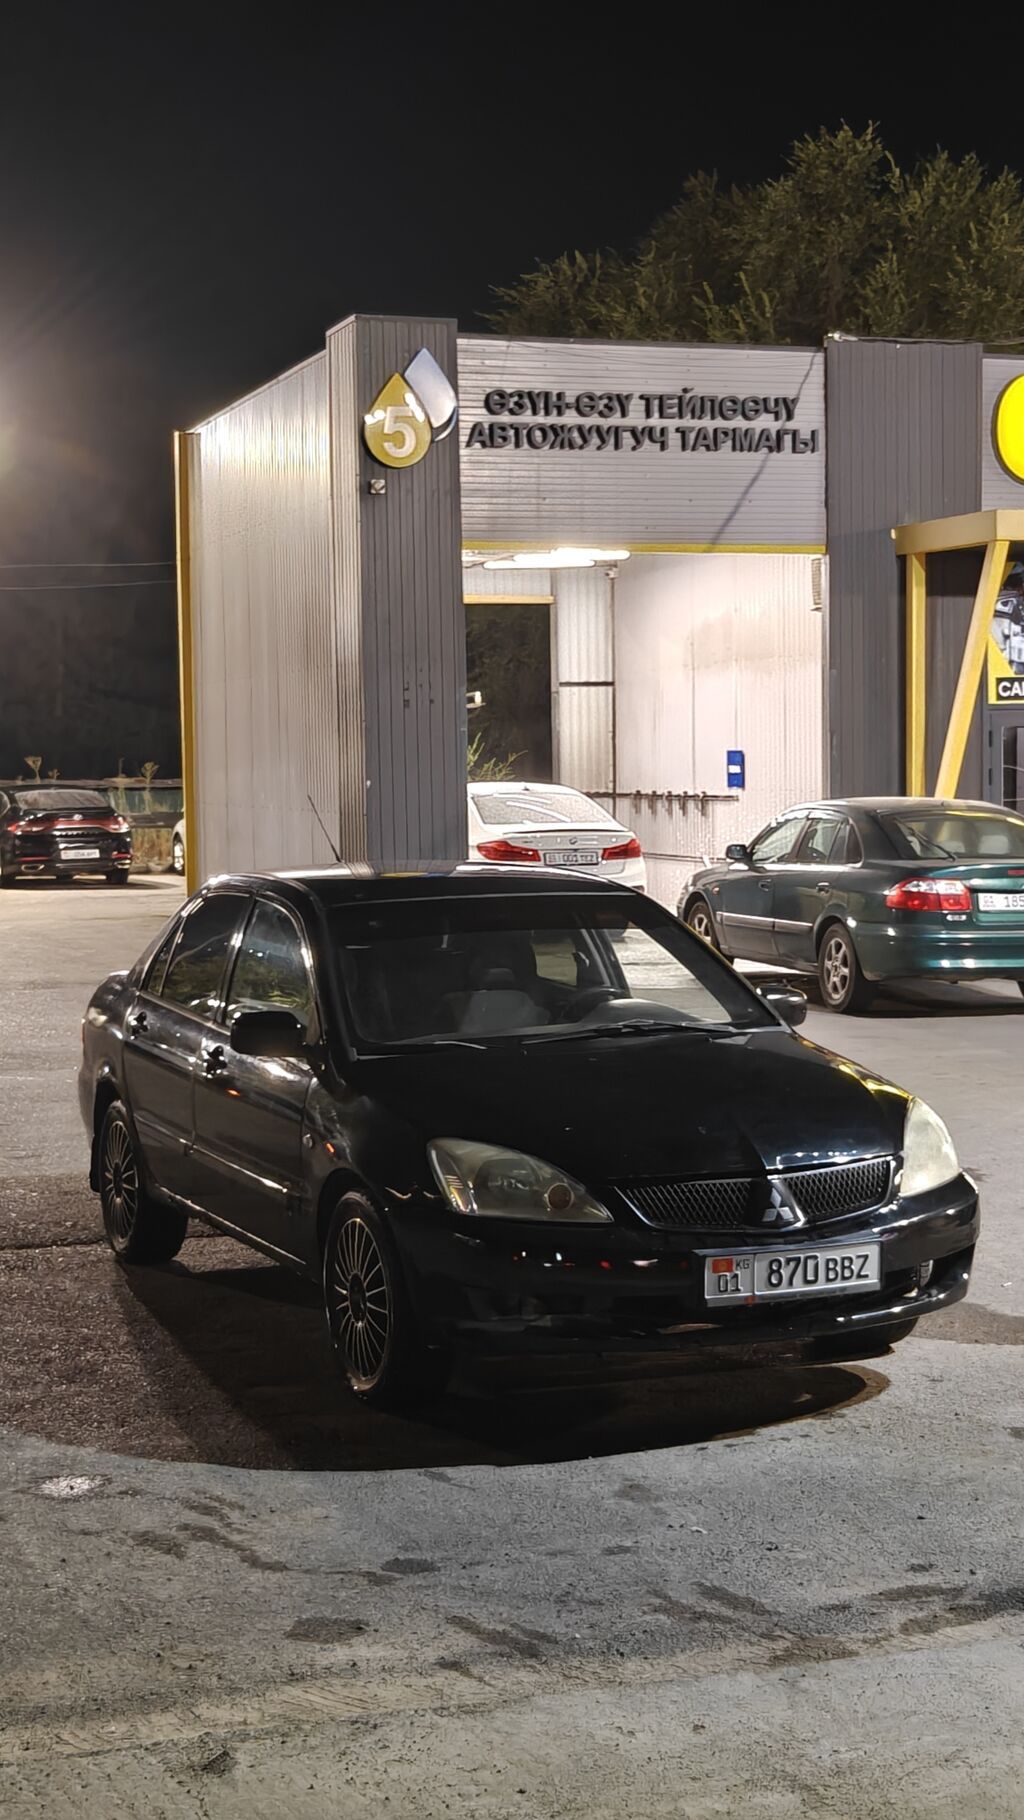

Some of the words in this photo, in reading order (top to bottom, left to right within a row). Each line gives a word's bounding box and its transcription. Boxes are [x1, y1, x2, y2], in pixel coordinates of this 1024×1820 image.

[383, 406, 417, 458] 5
[466, 421, 669, 452] АВТОЖУУГУЧ
[675, 426, 820, 454] ТАРМАГЫ
[998, 680, 1024, 697] СА
[735, 1258, 751, 1270] KG
[767, 1254, 820, 1288] 870
[825, 1253, 870, 1283] BBZ
[718, 1272, 742, 1293] 01
